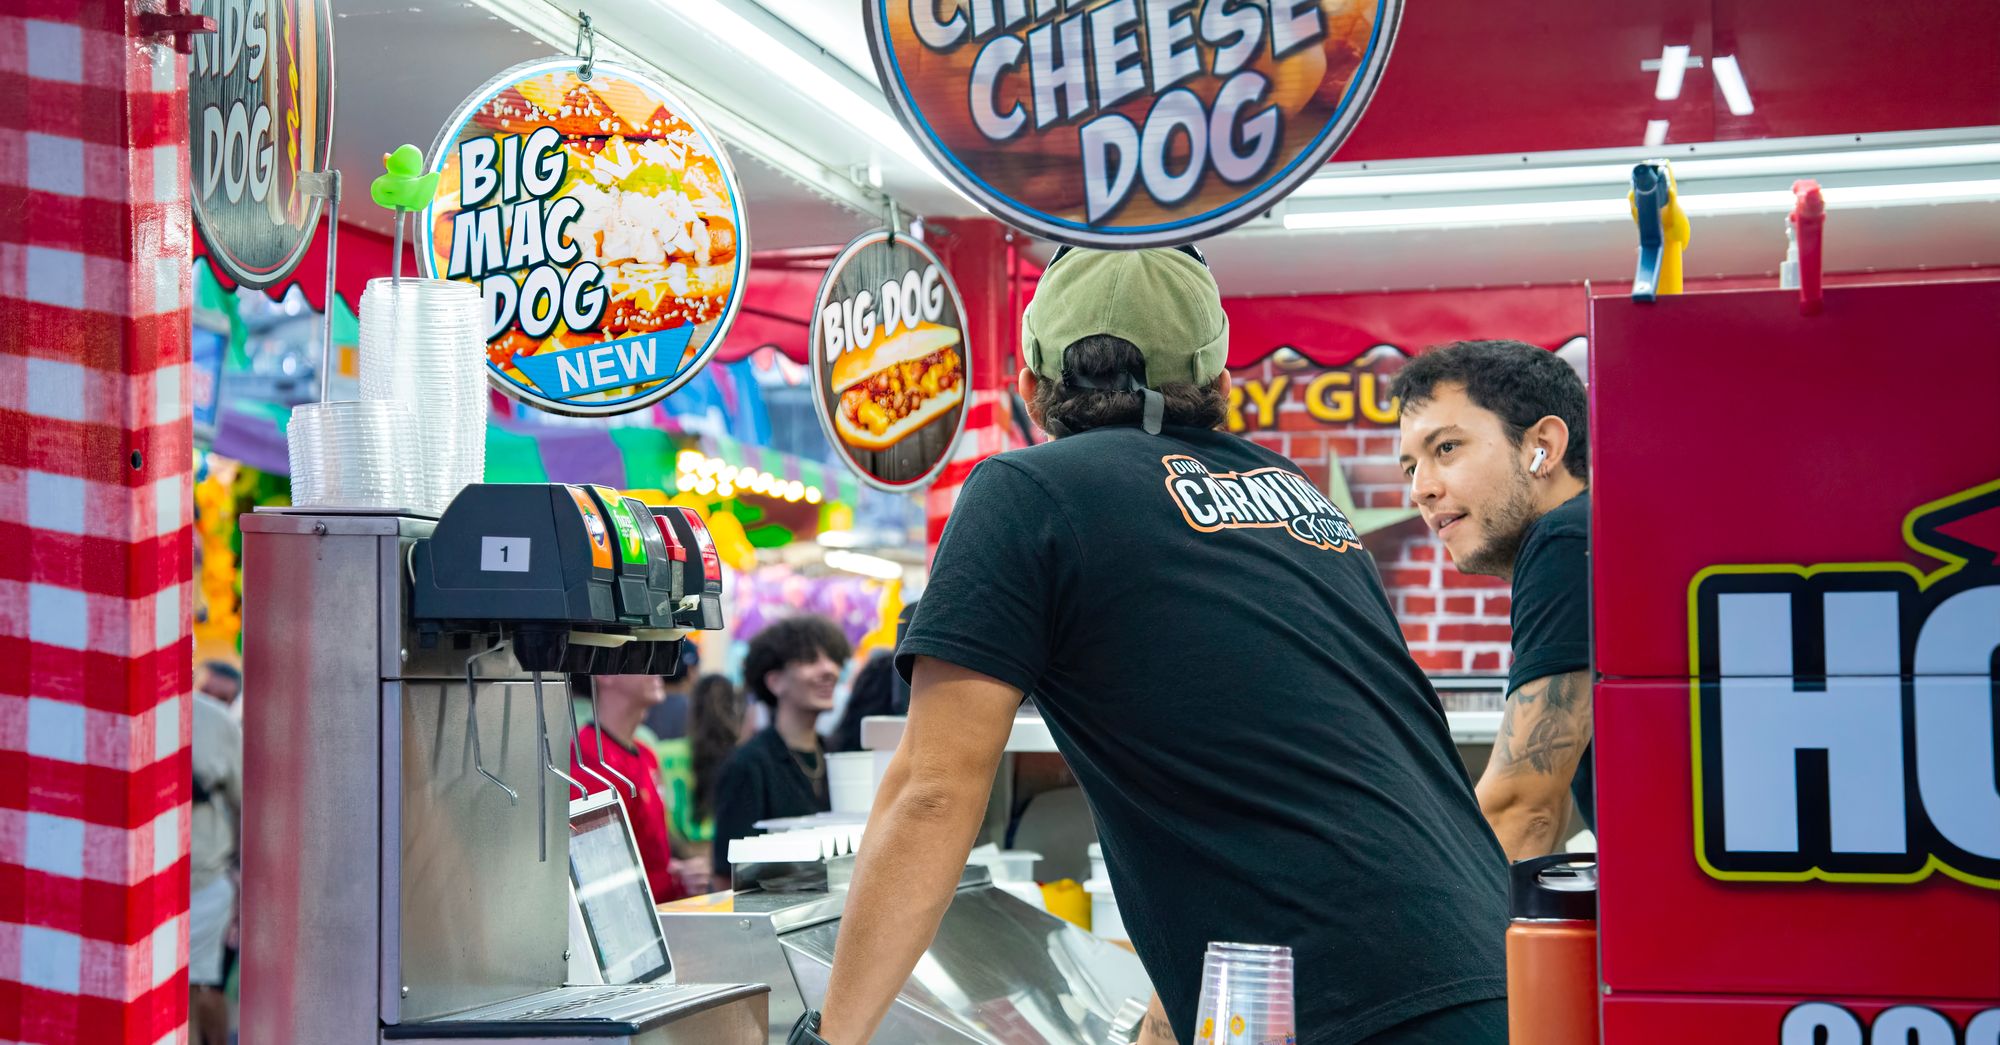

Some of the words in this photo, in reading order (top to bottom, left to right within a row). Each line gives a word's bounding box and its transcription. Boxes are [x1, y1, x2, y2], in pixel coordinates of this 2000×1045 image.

[203, 101, 274, 204] DOG
[460, 126, 566, 208] BIG
[1080, 71, 1279, 225] DOG
[448, 197, 584, 278] MAC
[482, 262, 607, 341] DOG
[822, 290, 877, 363] BIG
[881, 263, 945, 337] DOG
[556, 338, 658, 393] NEW
[1171, 460, 1205, 475] OUR
[500, 545, 509, 563] 1
